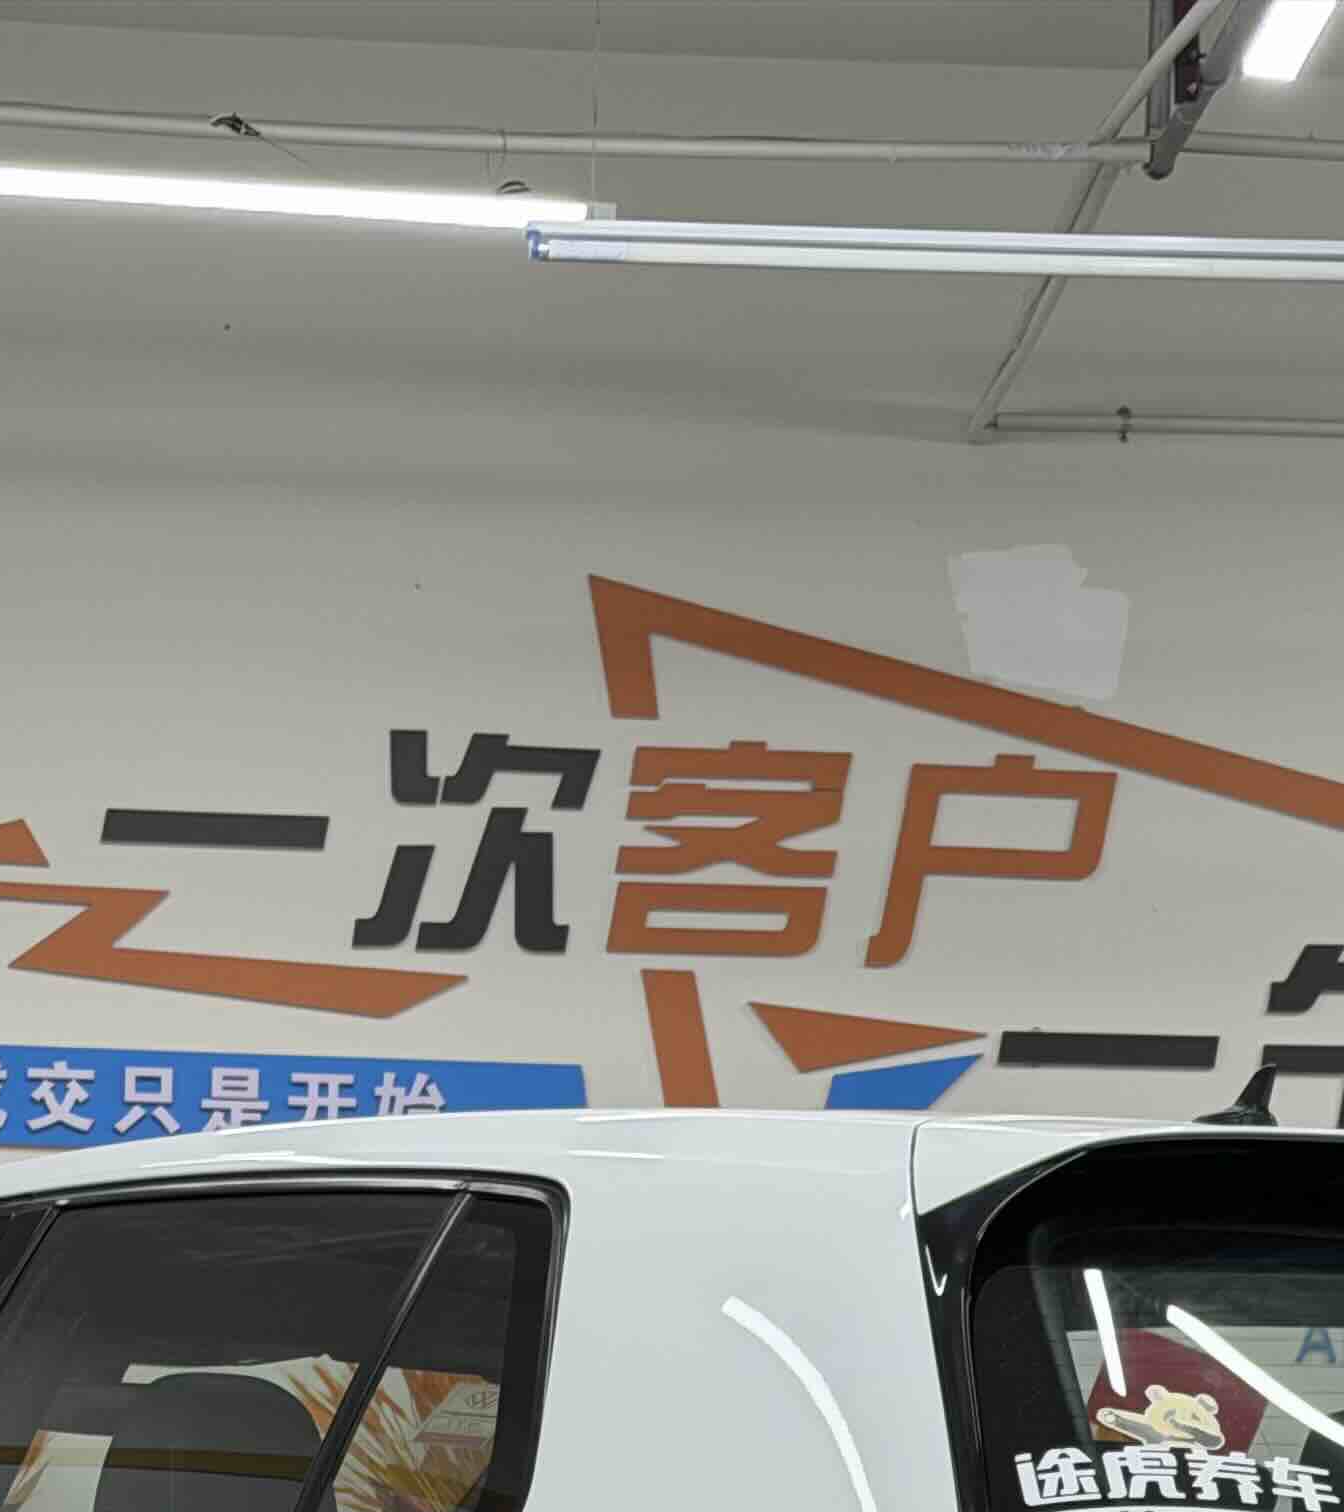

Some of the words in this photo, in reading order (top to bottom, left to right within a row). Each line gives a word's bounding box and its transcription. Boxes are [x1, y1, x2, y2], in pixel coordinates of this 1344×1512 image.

[100, 728, 1118, 968] 一次客户
[1013, 1445, 1341, 1512] 途虎养车
